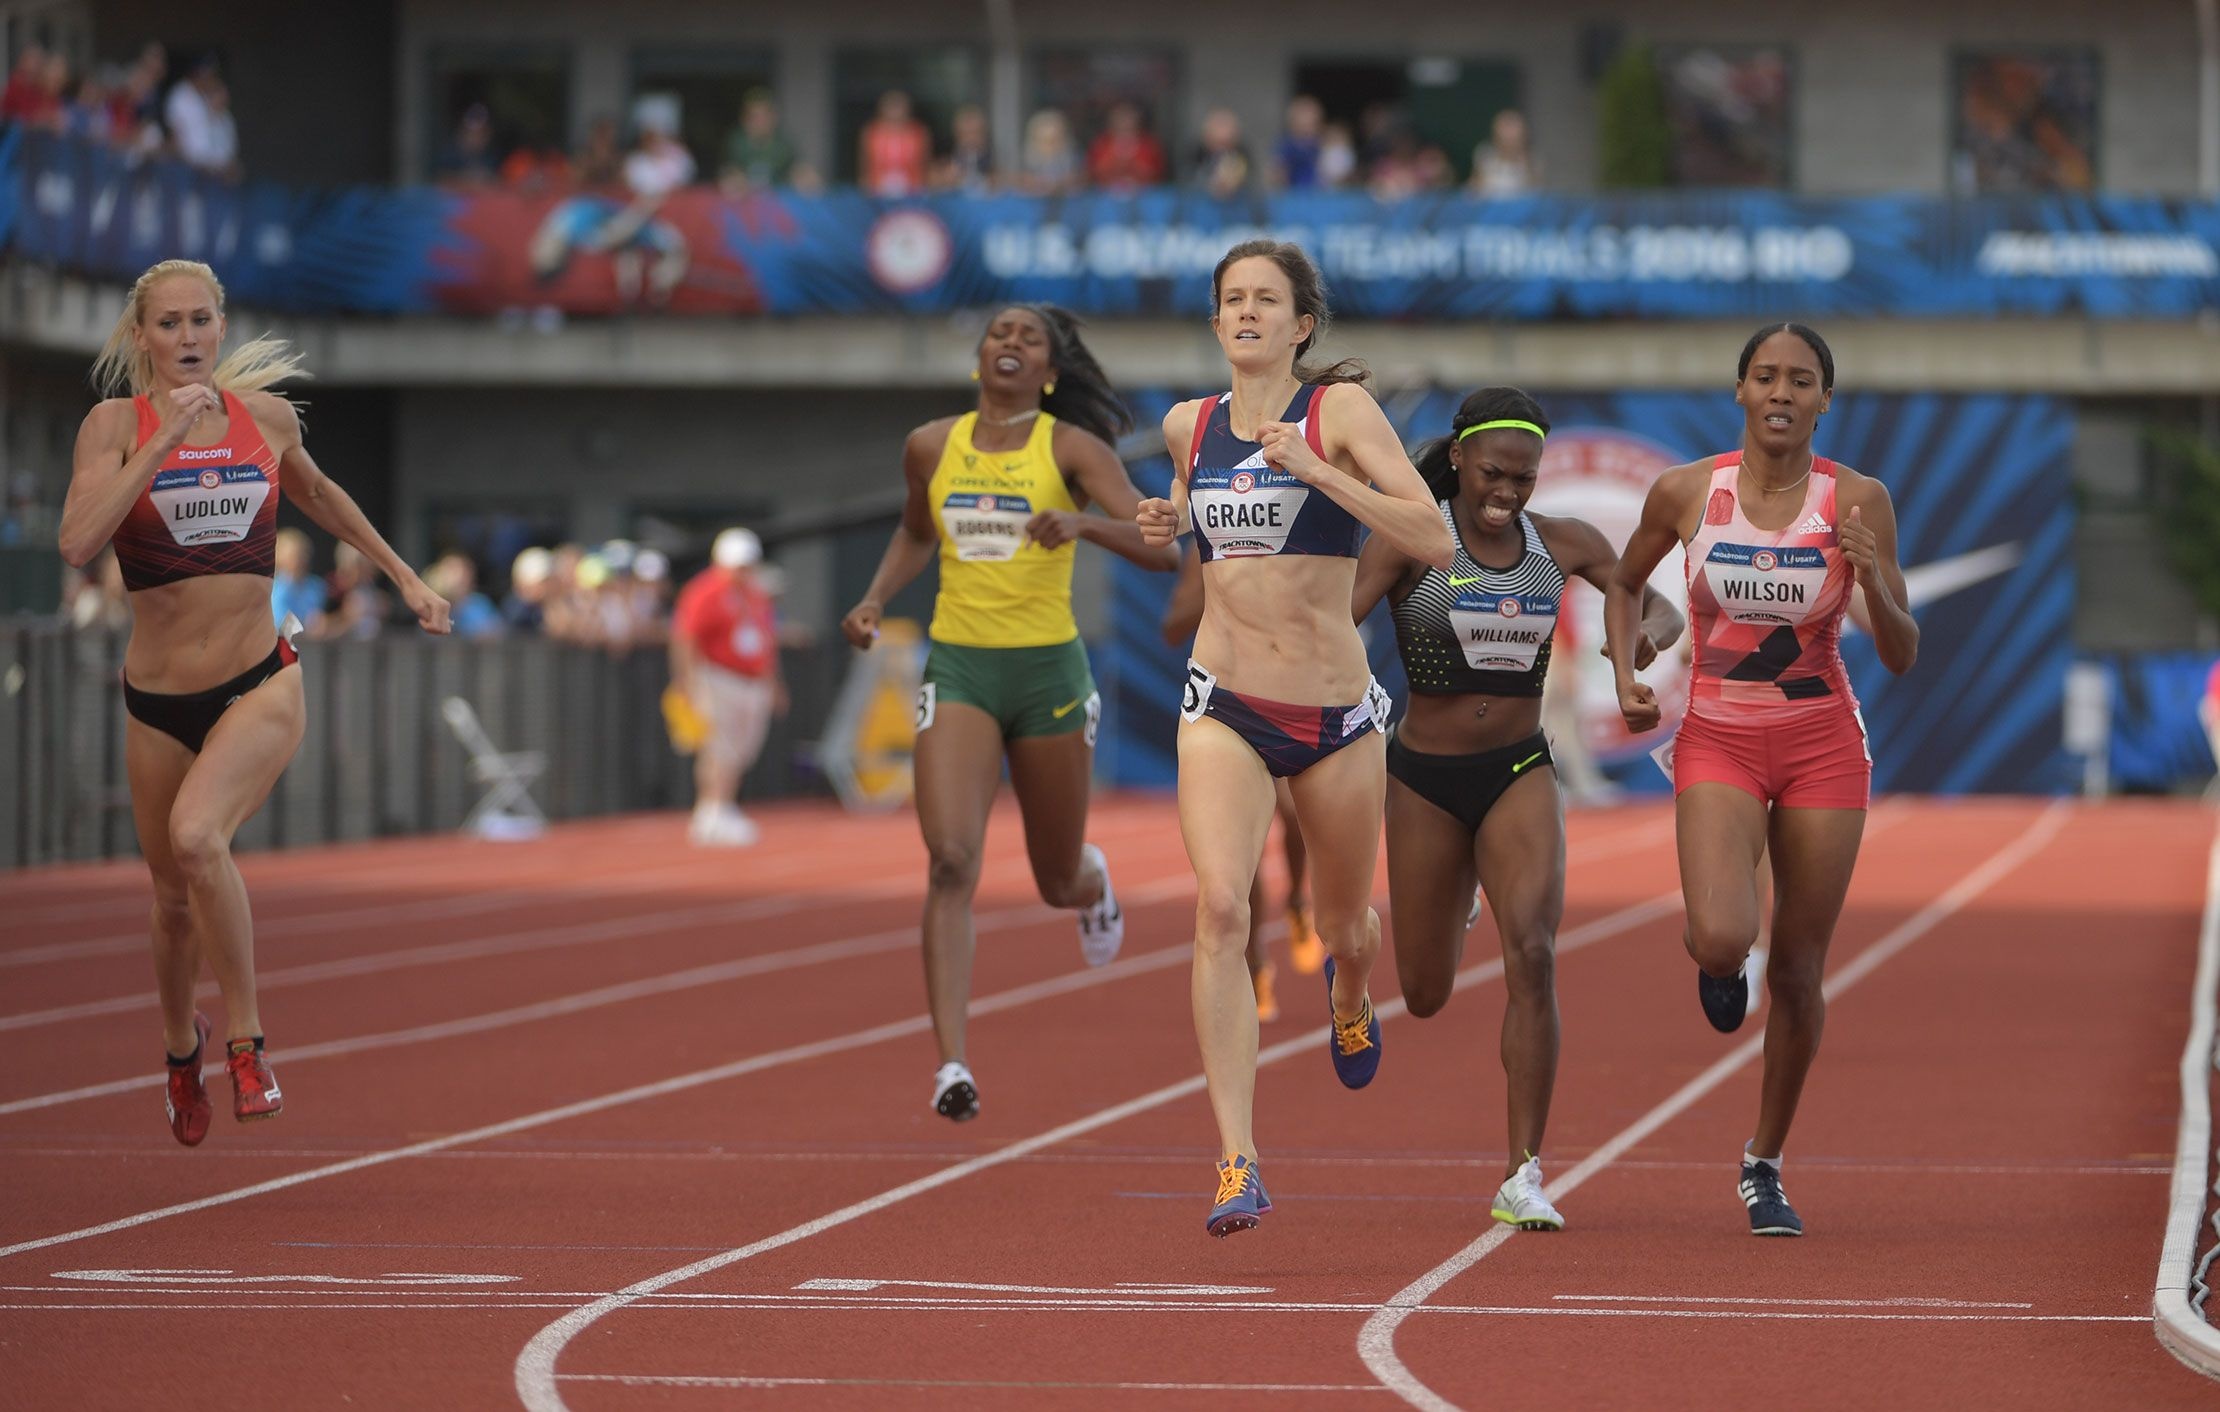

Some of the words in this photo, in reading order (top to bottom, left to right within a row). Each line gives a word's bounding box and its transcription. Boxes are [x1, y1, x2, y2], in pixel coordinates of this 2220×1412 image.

[178, 447, 232, 460] saucony
[175, 497, 249, 521] LUDLOW
[1206, 503, 1283, 529] GRACE
[956, 519, 1017, 537] ROGERS
[1798, 523, 1833, 535] adidas
[1723, 579, 1805, 604] WILSON
[1470, 628, 1540, 645] WILLIAMS
